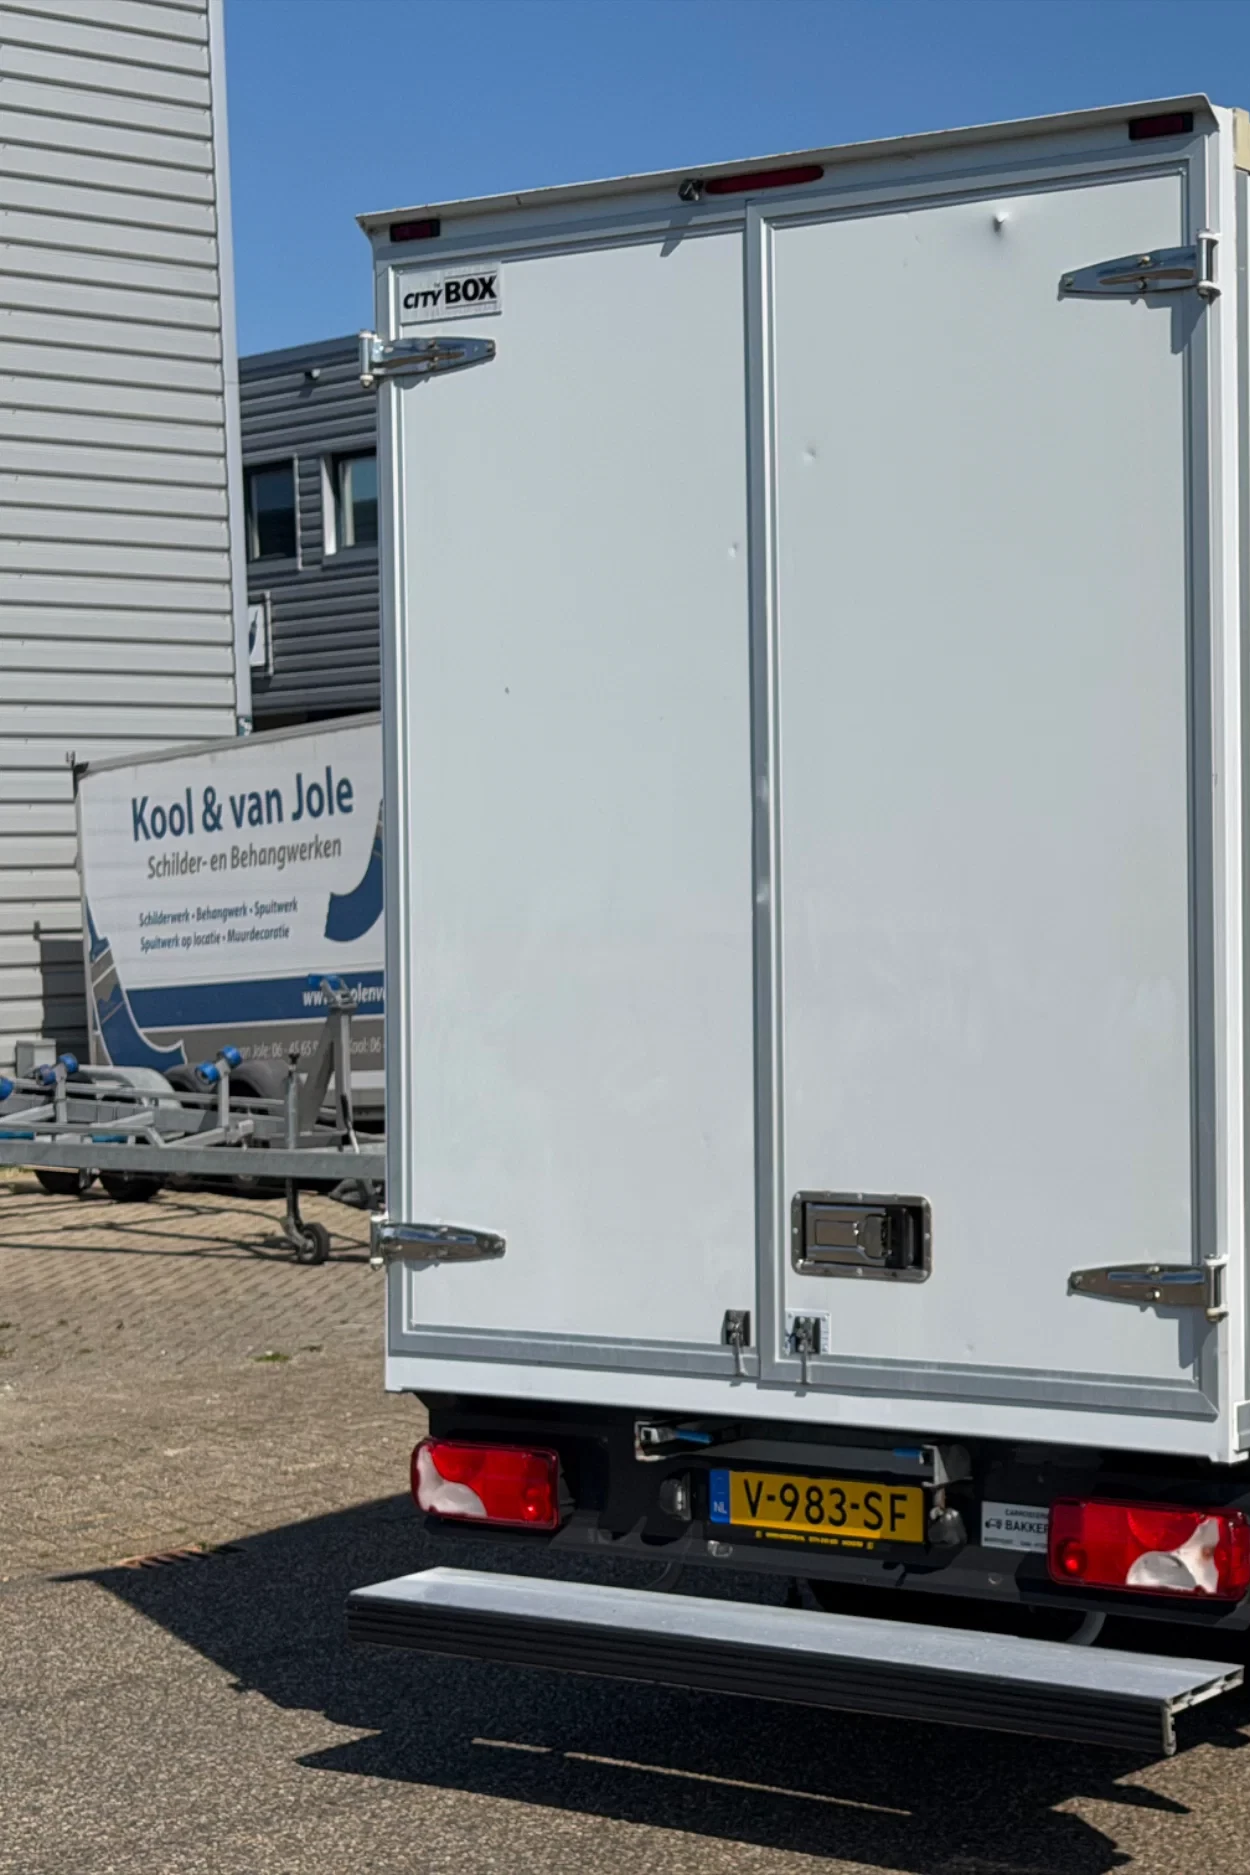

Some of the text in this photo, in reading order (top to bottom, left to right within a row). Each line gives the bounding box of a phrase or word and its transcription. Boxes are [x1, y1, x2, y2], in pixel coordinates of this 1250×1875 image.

[403, 275, 497, 310] CITY BOX
[131, 765, 354, 842] Kool & van Jole
[148, 834, 341, 879] Schilder- en Behangwerken
[139, 896, 298, 927] Schilderwerk Behangwerk Spuitwerk
[140, 924, 290, 953] Spuitwerk op locatie Muurdecoratie
[713, 1501, 728, 1514] NL
[743, 1478, 907, 1532] V-983-SF
